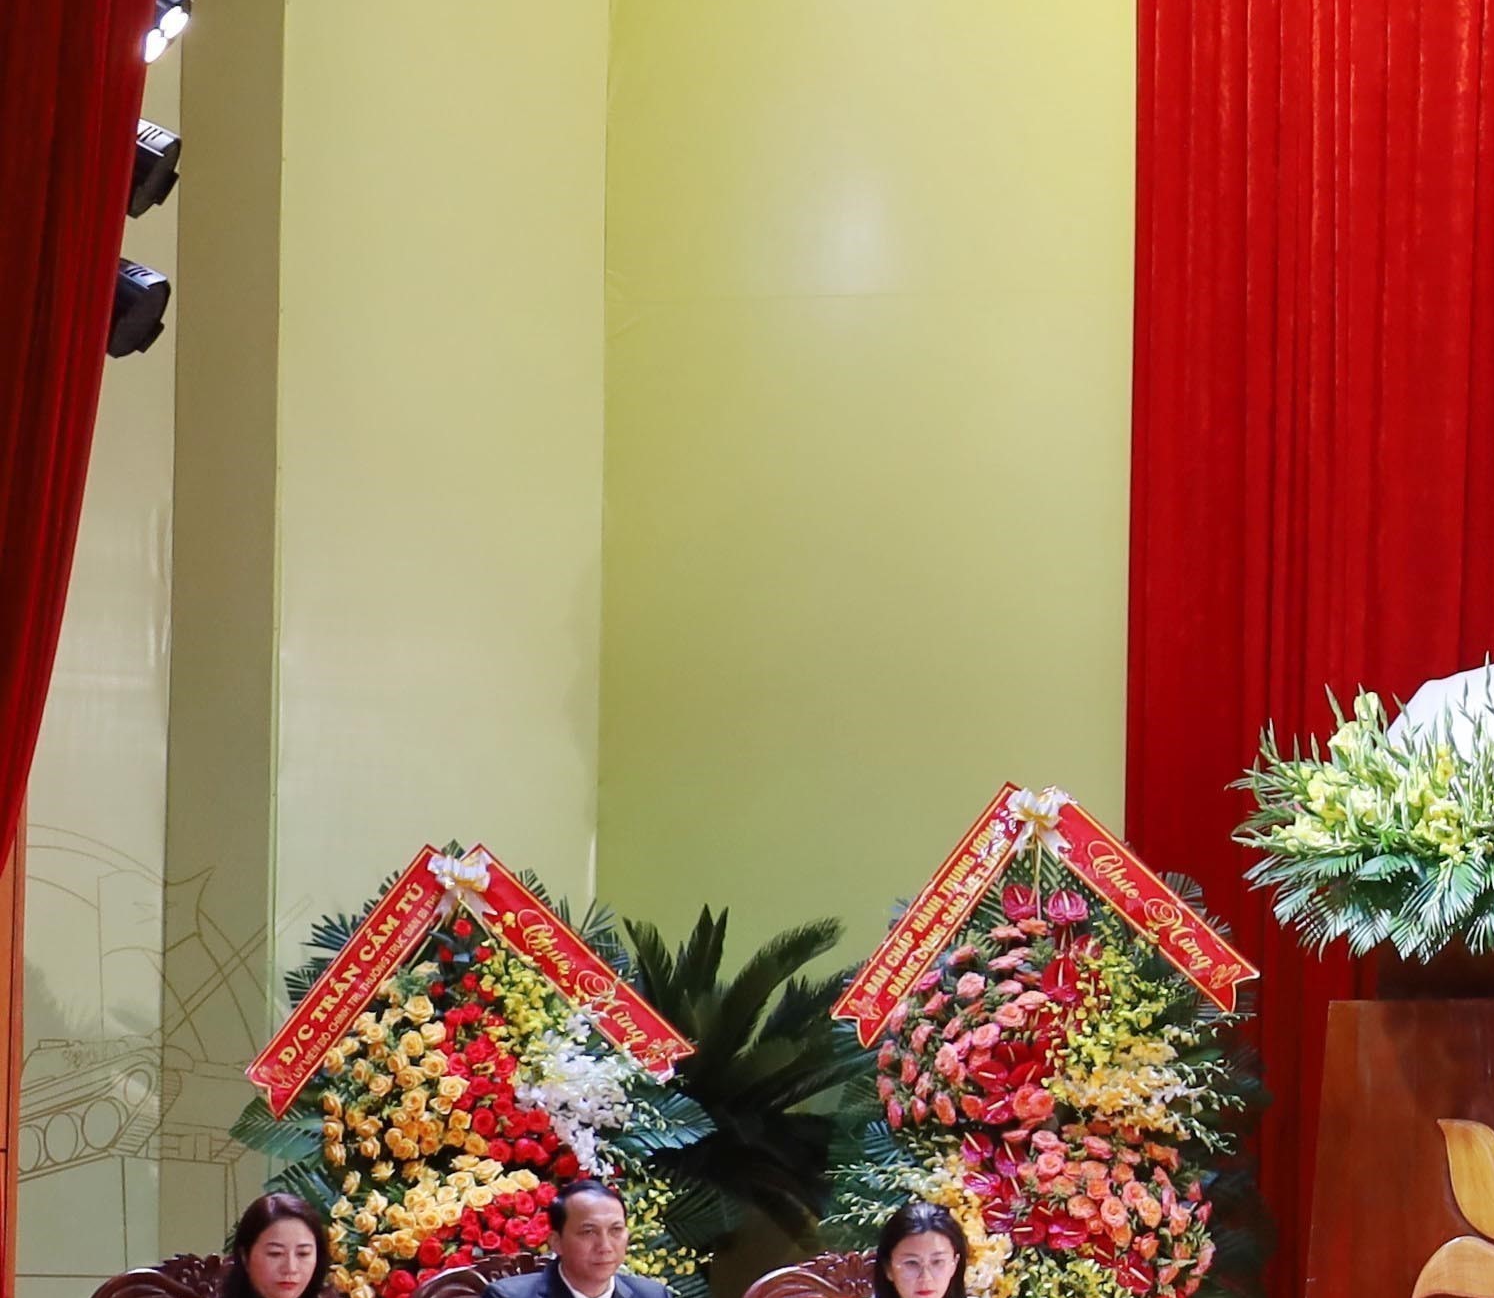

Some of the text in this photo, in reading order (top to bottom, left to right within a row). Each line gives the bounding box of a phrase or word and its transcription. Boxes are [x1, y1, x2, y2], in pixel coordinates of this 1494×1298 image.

[277, 1021, 316, 1067] Đ/C
[308, 959, 363, 1025] TRẦN
[394, 879, 426, 916] TÚ
